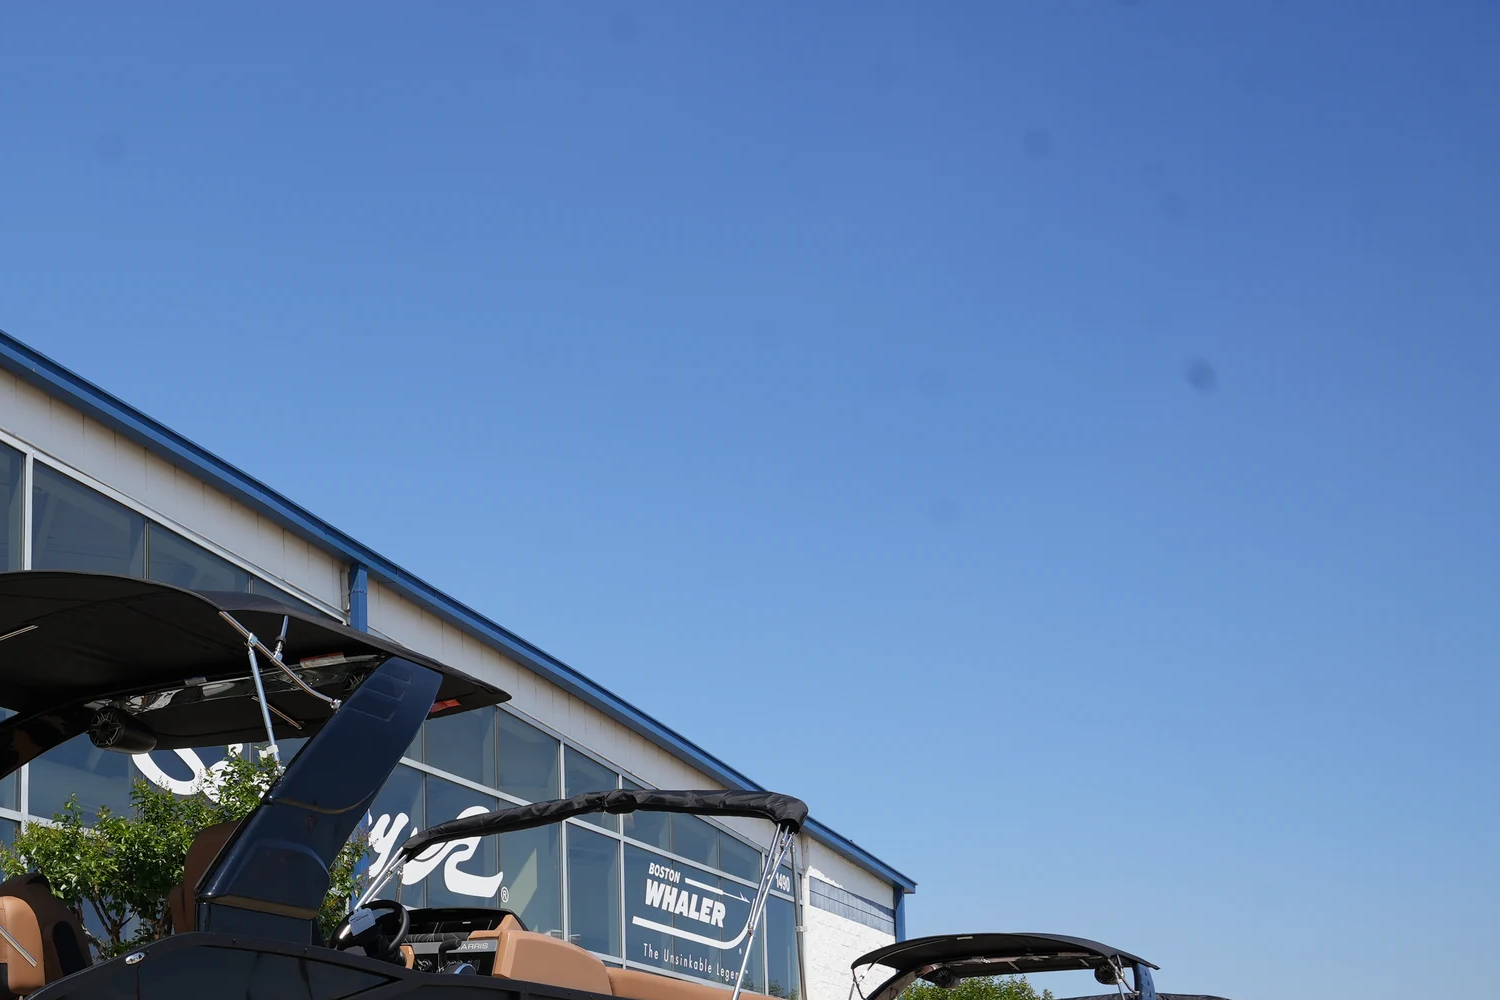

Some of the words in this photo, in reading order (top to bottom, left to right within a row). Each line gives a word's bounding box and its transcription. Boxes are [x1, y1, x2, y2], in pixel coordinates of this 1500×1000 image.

[649, 862, 681, 884] BOSTON
[775, 872, 791, 893] 1490
[645, 878, 726, 928] WHALER
[457, 942, 489, 950] ARRIS
[643, 943, 659, 960] The
[663, 948, 712, 974] Unsinkable
[716, 963, 743, 982] Legen
